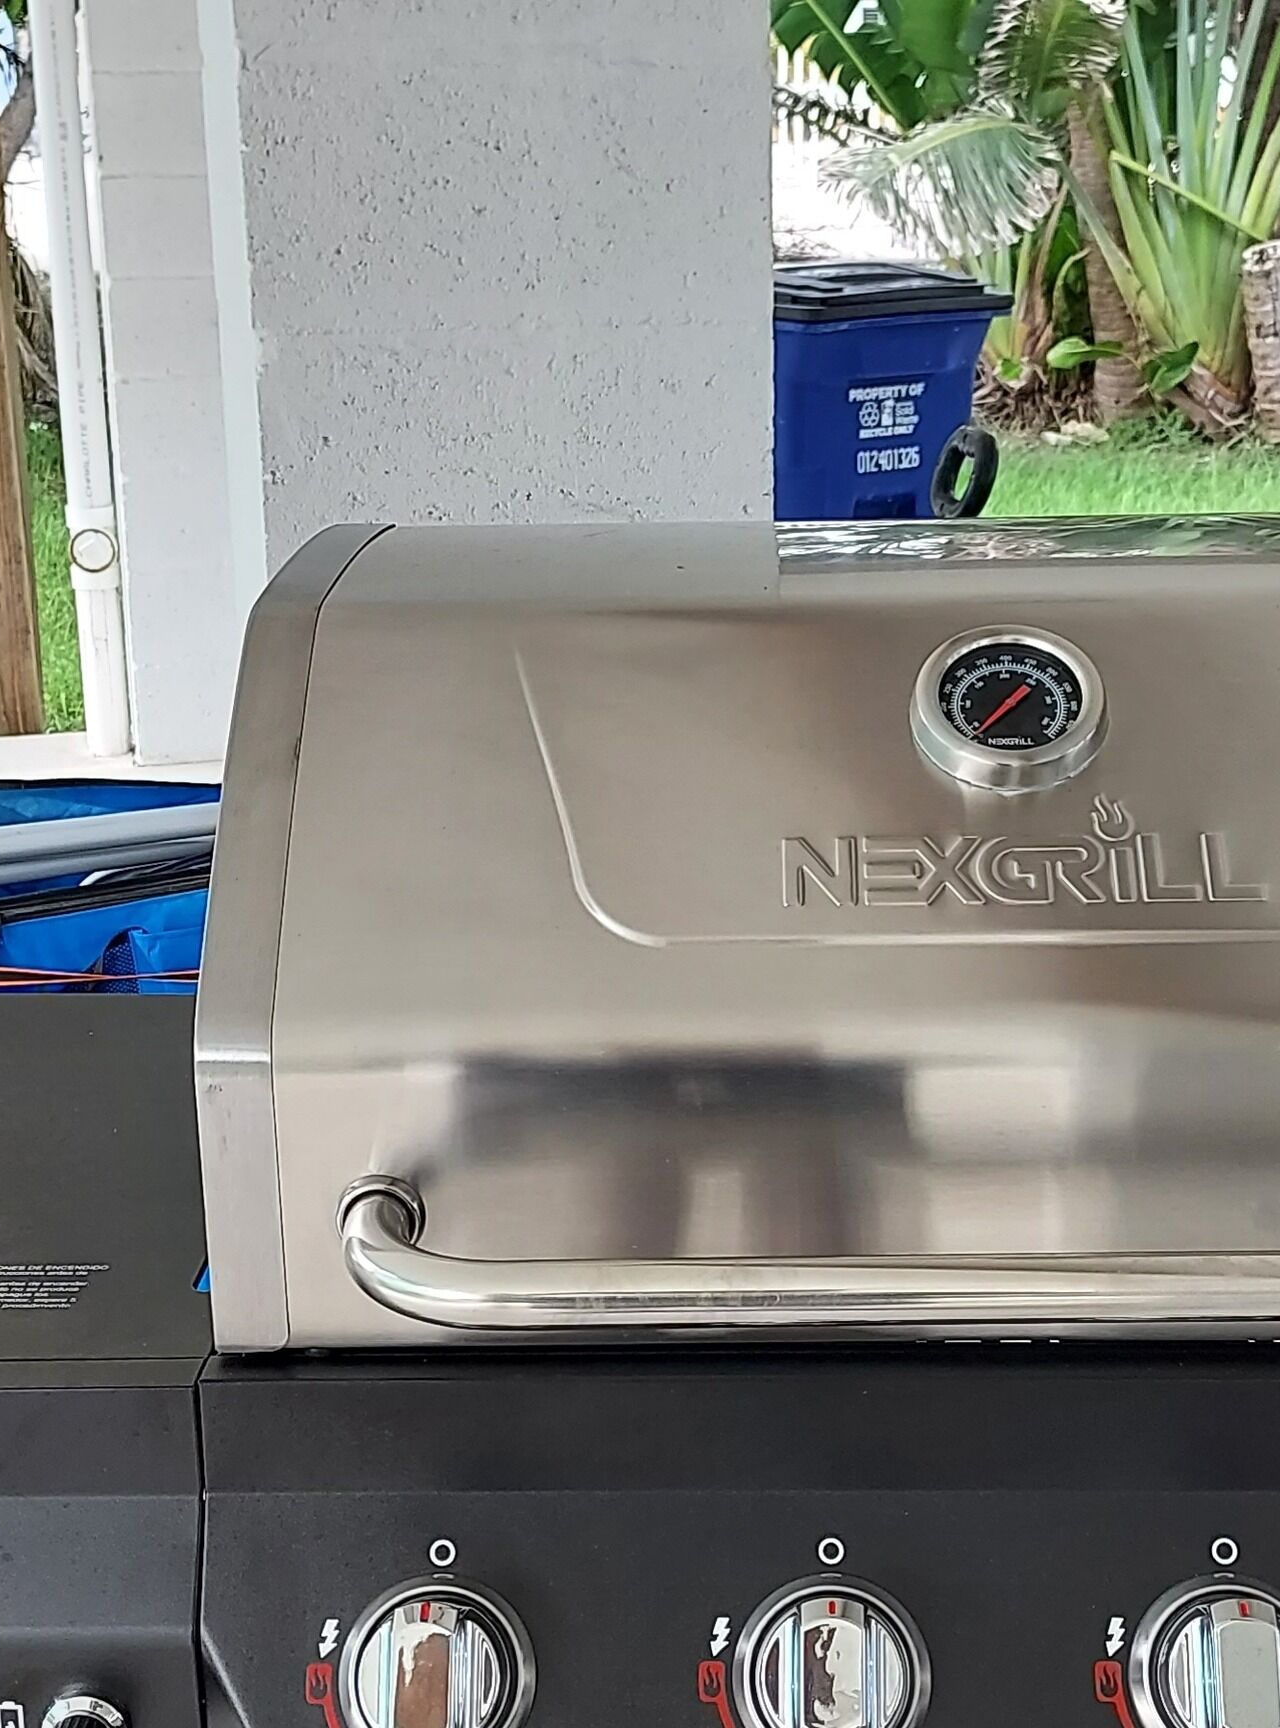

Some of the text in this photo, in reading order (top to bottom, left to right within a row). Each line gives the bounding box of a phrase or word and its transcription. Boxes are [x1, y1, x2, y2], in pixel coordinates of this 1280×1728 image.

[849, 382, 925, 402] PROPERTY OF
[857, 446, 920, 474] 012401326
[988, 737, 1035, 746] NEXGRILL
[782, 832, 1269, 907] NEXGRILL
